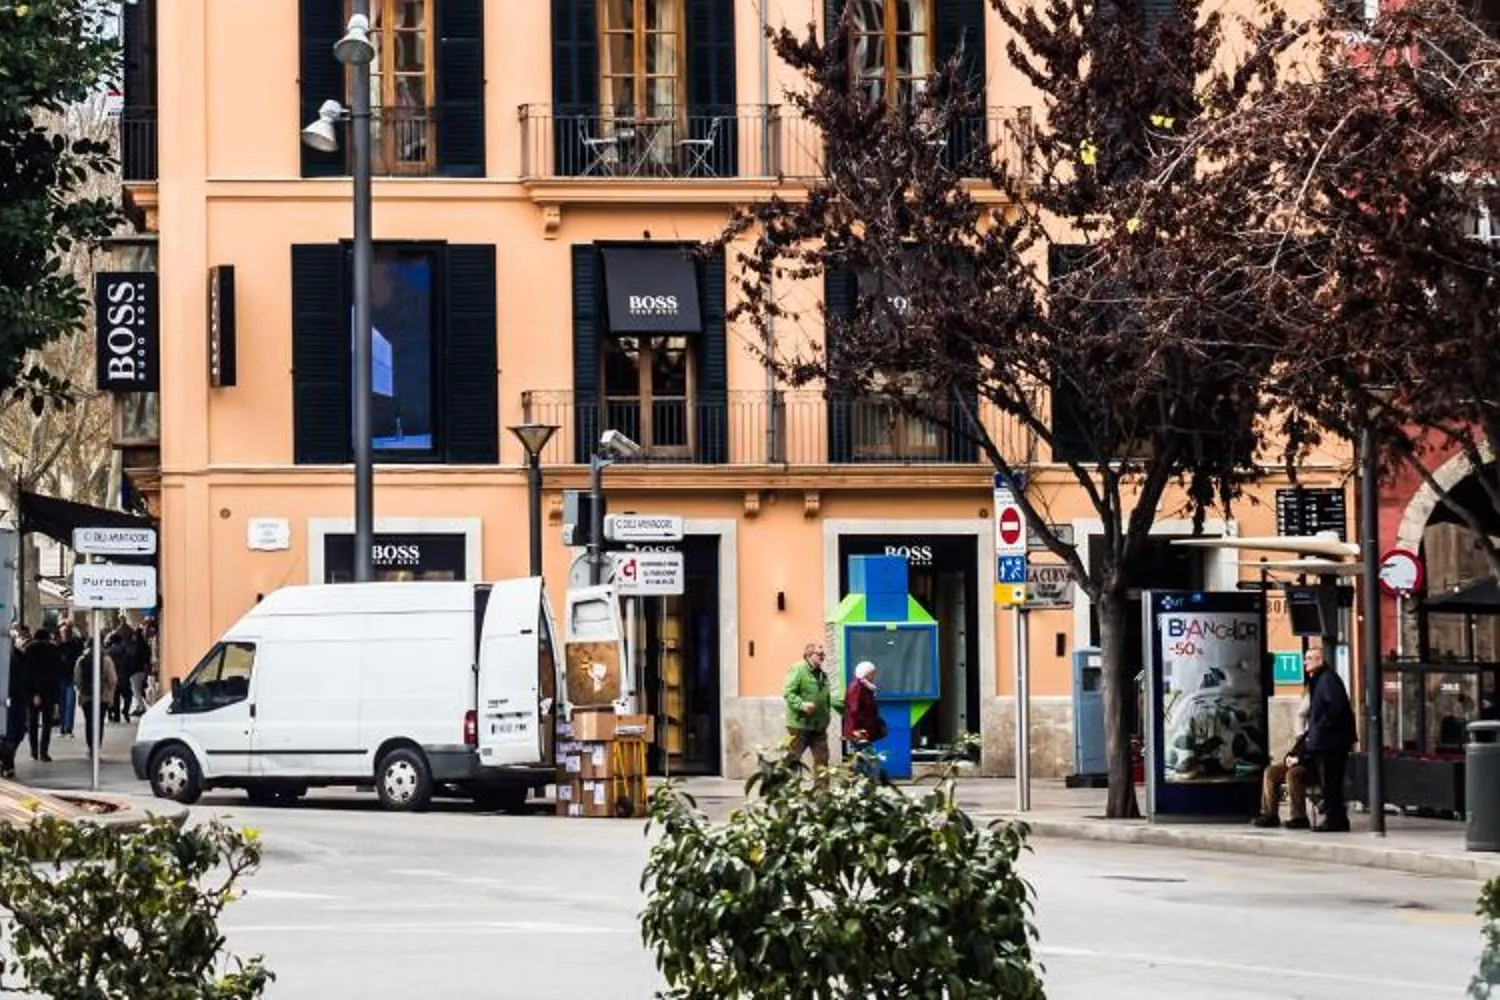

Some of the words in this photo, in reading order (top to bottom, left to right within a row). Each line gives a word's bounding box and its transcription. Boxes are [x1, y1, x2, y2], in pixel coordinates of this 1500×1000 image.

[629, 295, 678, 309] BOSS
[107, 281, 135, 380] BOSS
[372, 545, 420, 560] BOSS
[884, 545, 933, 561] BOSS
